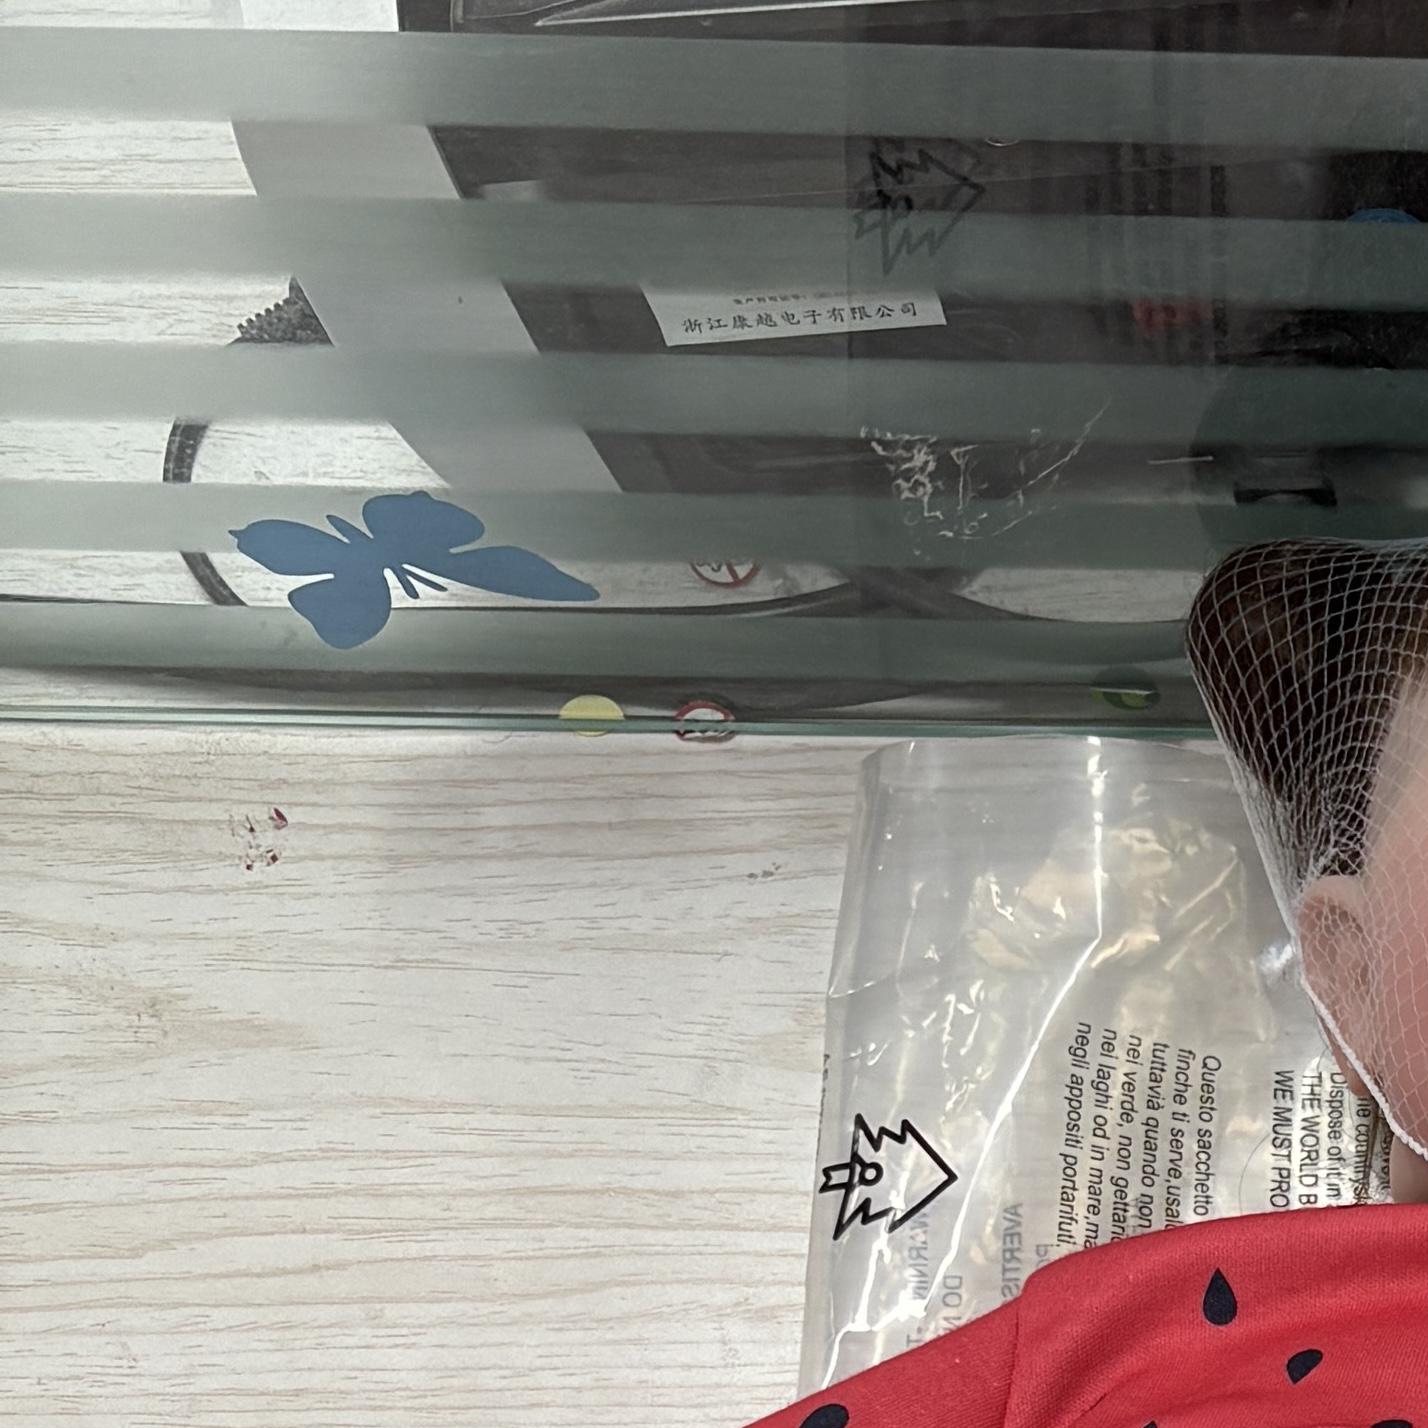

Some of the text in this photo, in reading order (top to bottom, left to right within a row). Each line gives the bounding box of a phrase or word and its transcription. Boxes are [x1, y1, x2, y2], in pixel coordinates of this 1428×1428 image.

[1064, 1021, 1092, 1150] negli appositi
[1090, 1028, 1119, 1161] nei laghi od in
[1115, 1034, 1143, 1172] nei verde, non
[1138, 1042, 1170, 1229] tuttavià quando non
[1171, 1111, 1190, 1124] ti
[1172, 1048, 1196, 1106] finche
[1193, 1055, 1222, 1216] Questo sacchetto
[1271, 1106, 1293, 1163] MUST
[1273, 1070, 1295, 1101] WE
[1299, 1072, 1322, 1187] THE WORLD
